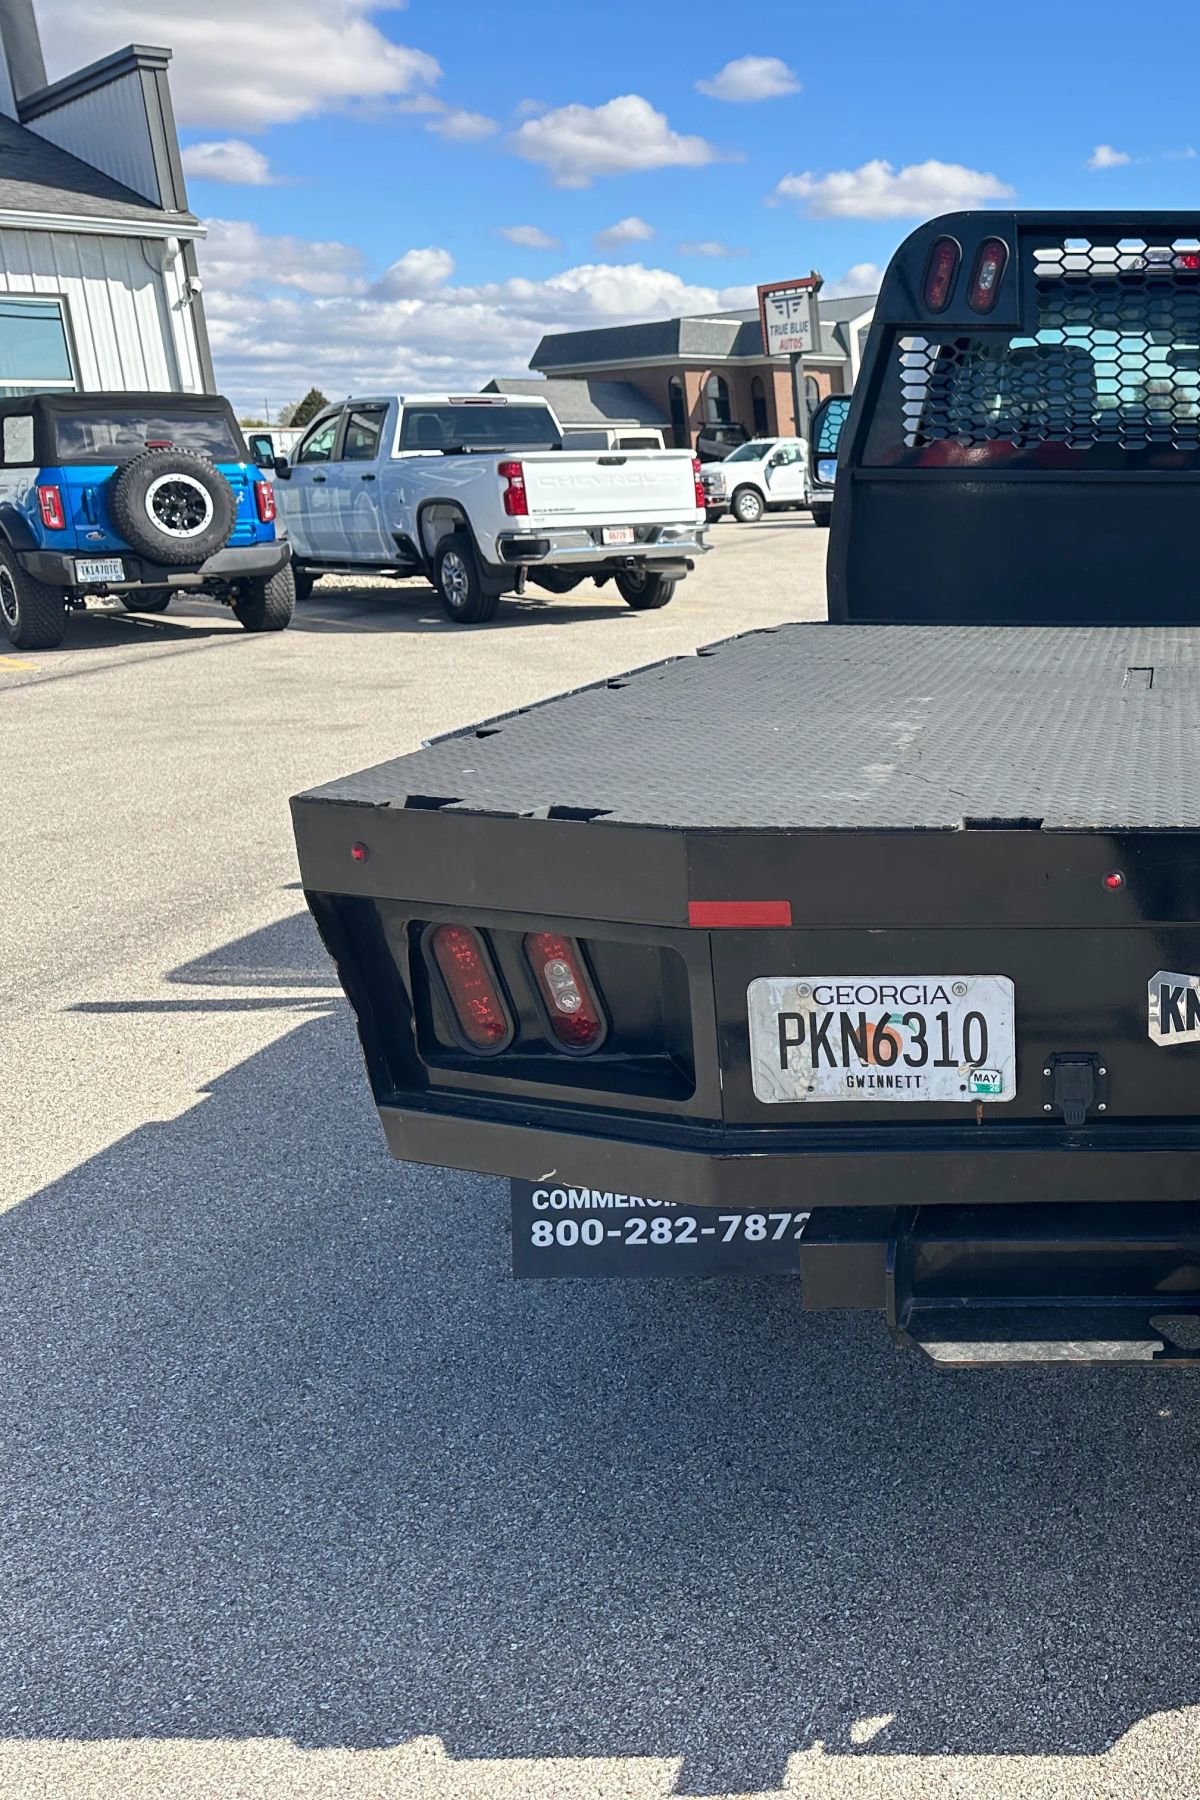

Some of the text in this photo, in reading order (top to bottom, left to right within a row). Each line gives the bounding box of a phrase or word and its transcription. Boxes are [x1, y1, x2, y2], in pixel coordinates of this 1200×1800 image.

[769, 321, 809, 336] TRUE BLUE
[779, 337, 803, 351] AUTOS
[812, 985, 952, 1005] GEORGIA
[777, 1010, 988, 1069] PKN6310
[846, 1074, 922, 1089] GWINNETT
[974, 1073, 998, 1083] MAY
[531, 1189, 677, 1209] COMMER
